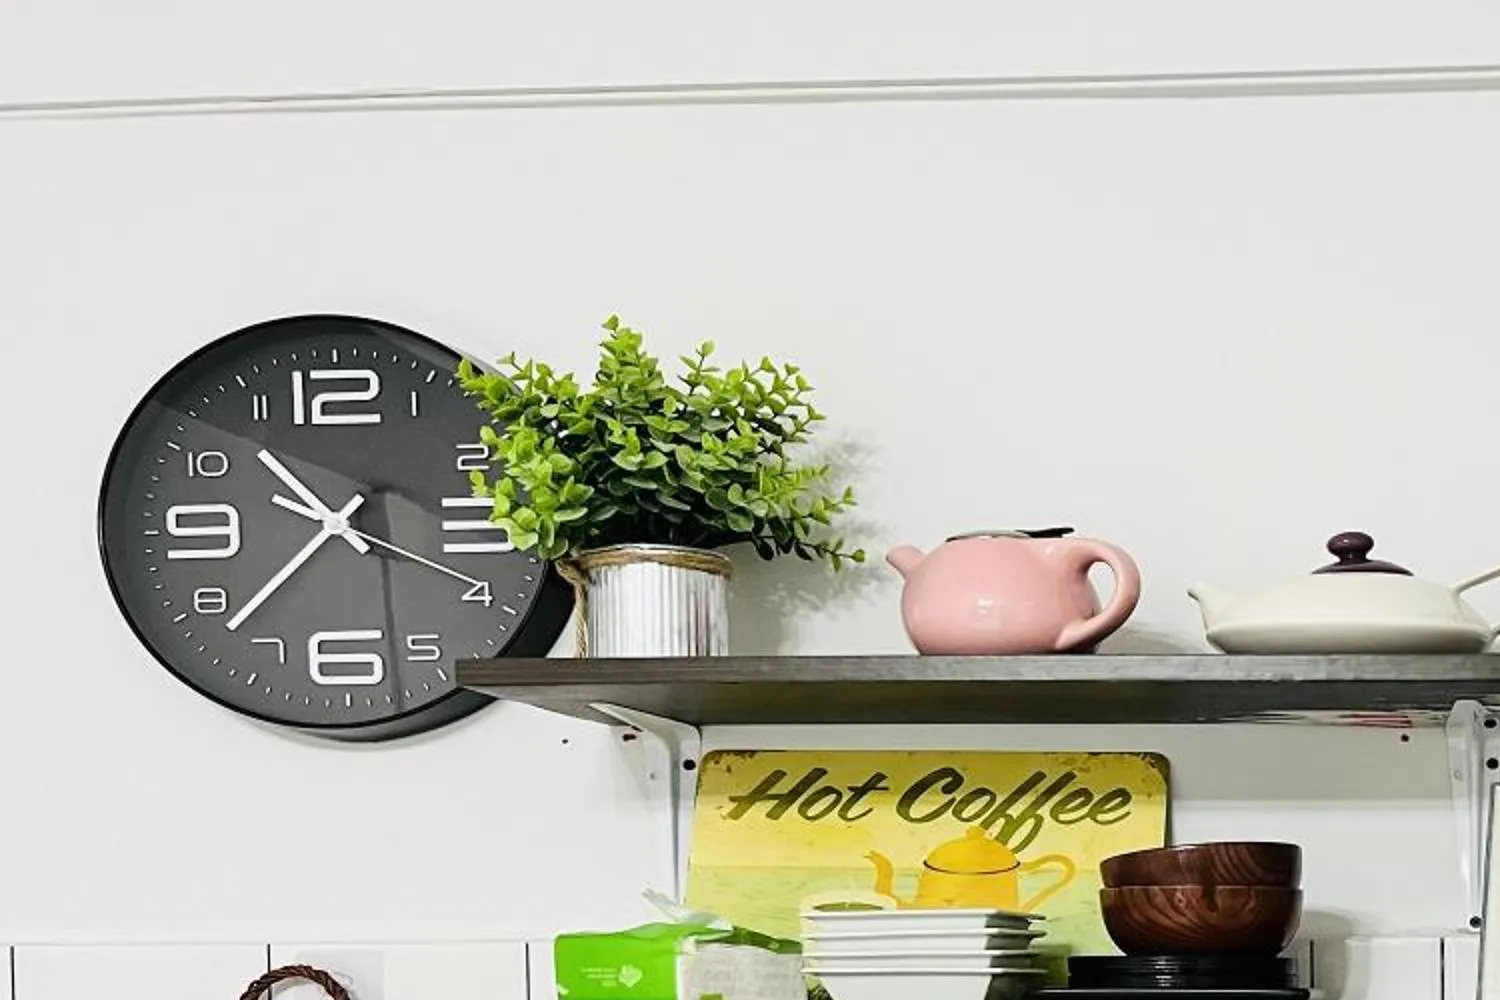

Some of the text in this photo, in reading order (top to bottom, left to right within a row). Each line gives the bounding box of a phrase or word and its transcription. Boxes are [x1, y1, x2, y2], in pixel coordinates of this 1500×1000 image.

[292, 369, 381, 425] 12
[188, 450, 229, 477] 10
[456, 444, 490, 470] 2
[165, 503, 240, 559] 9
[193, 587, 227, 613] 8
[461, 581, 493, 606] 4
[251, 638, 285, 664] 7
[308, 630, 384, 685] 6
[407, 634, 441, 662] 5
[719, 766, 1132, 855] Hot Coffee
